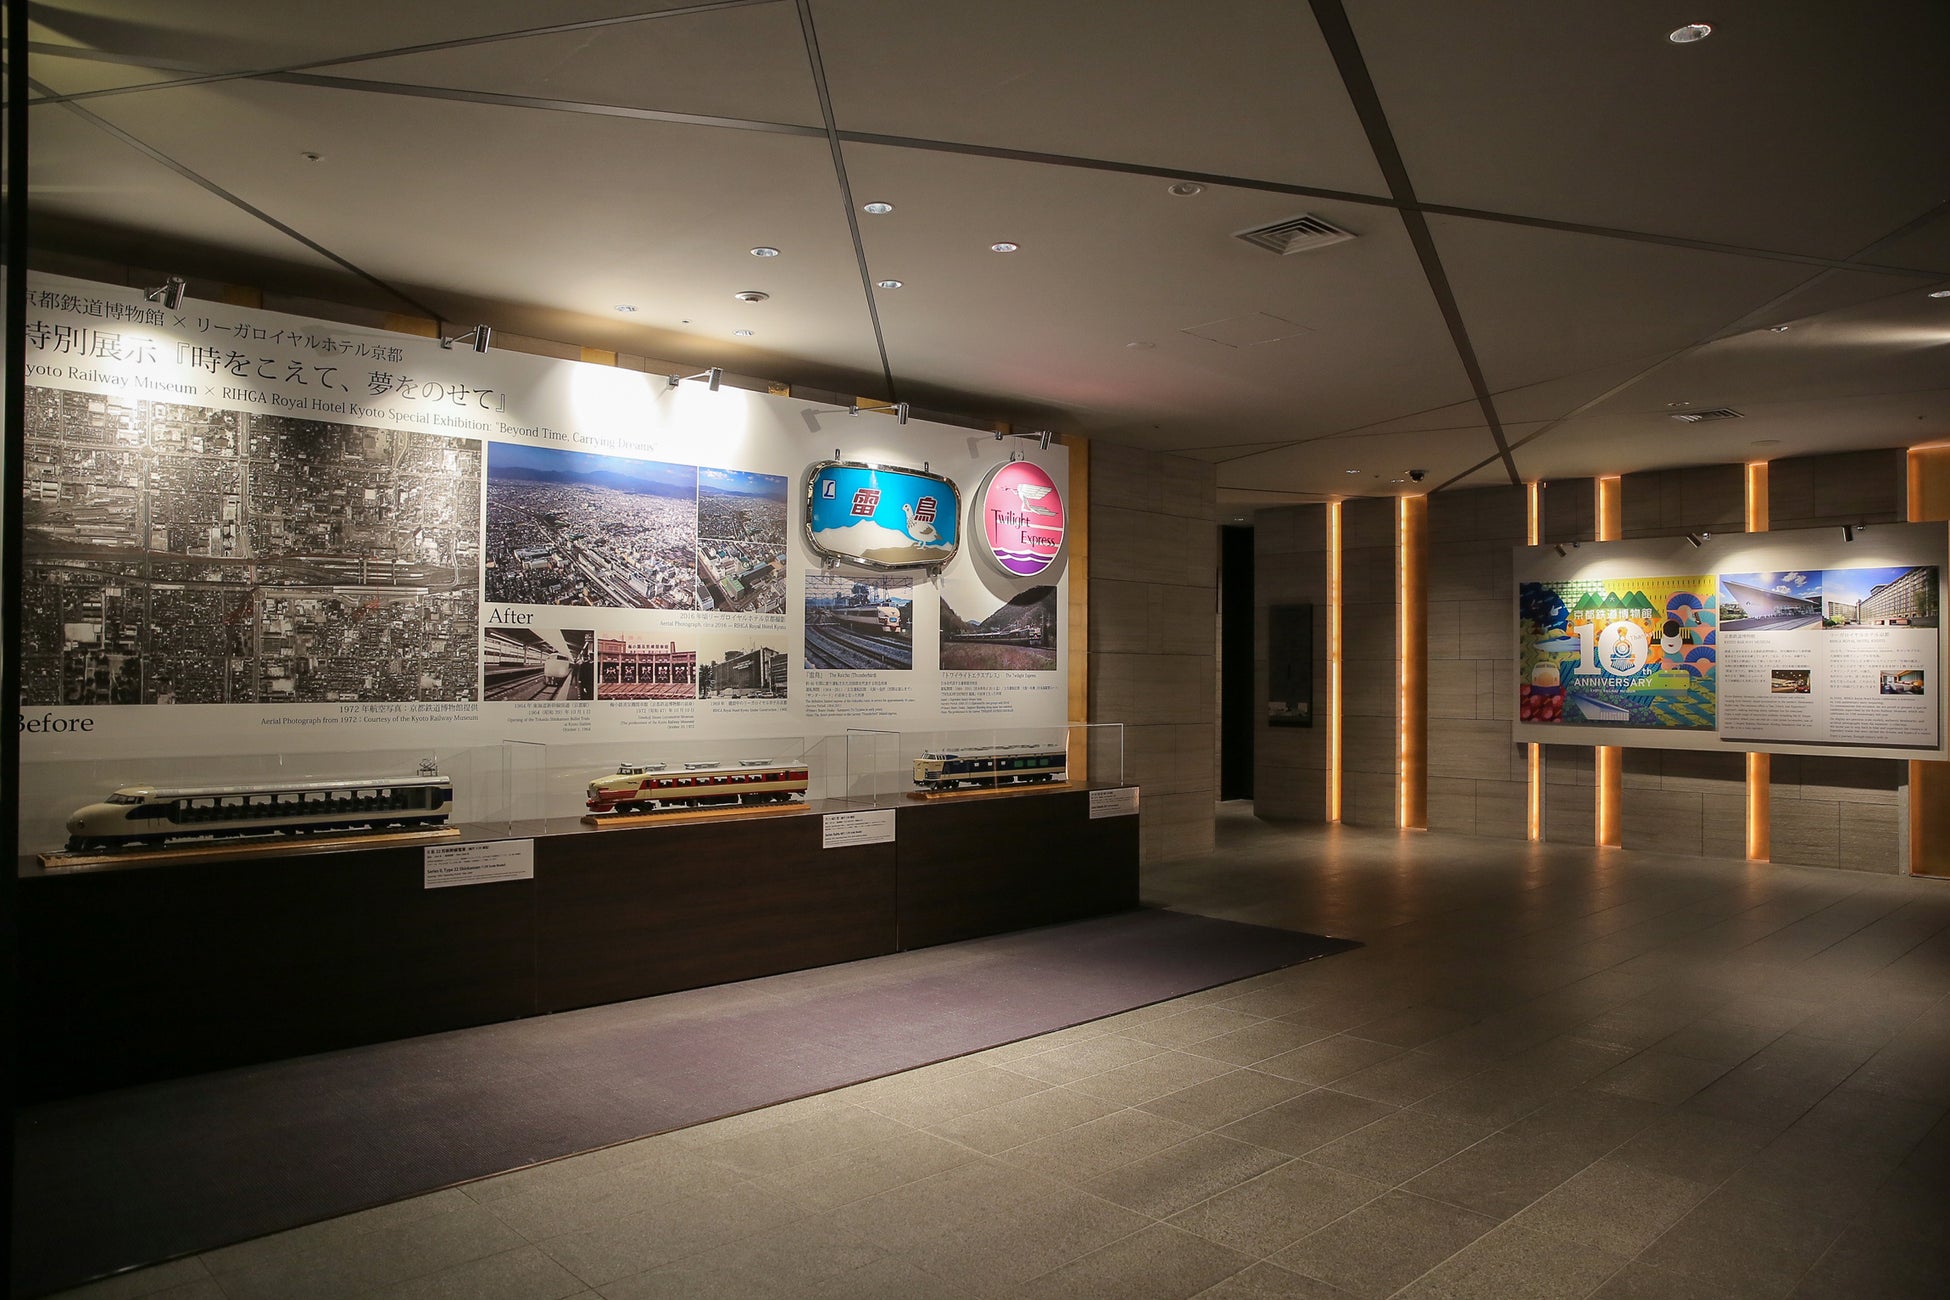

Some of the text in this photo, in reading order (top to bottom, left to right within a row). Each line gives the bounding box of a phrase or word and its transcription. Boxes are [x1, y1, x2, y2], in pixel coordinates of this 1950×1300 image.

[197, 317, 403, 364] リーガロイヤルホテル京都
[26, 364, 62, 379] yoto
[68, 365, 128, 388] Railway
[135, 376, 198, 396] Museum
[223, 387, 267, 404] RIHGA
[272, 394, 307, 413] Royal
[312, 398, 345, 414] Hotel
[350, 403, 385, 419] Kyoto
[389, 407, 429, 426] Special
[433, 414, 492, 432] Exhibition:
[542, 427, 570, 444] Time,
[573, 432, 615, 449] Carrying
[991, 509, 1030, 544] Twilight
[1021, 530, 1055, 547] Express
[488, 607, 534, 626] After
[1574, 608, 1652, 620] 京都鉄道博物館
[1574, 677, 1653, 688] ANNIVERSARY
[339, 705, 360, 713] 1972
[261, 717, 282, 726] Aerial
[283, 717, 322, 726] Photograph
[363, 716, 391, 724] Courtesy
[411, 715, 429, 723] Kyoto
[430, 714, 453, 723] Railway
